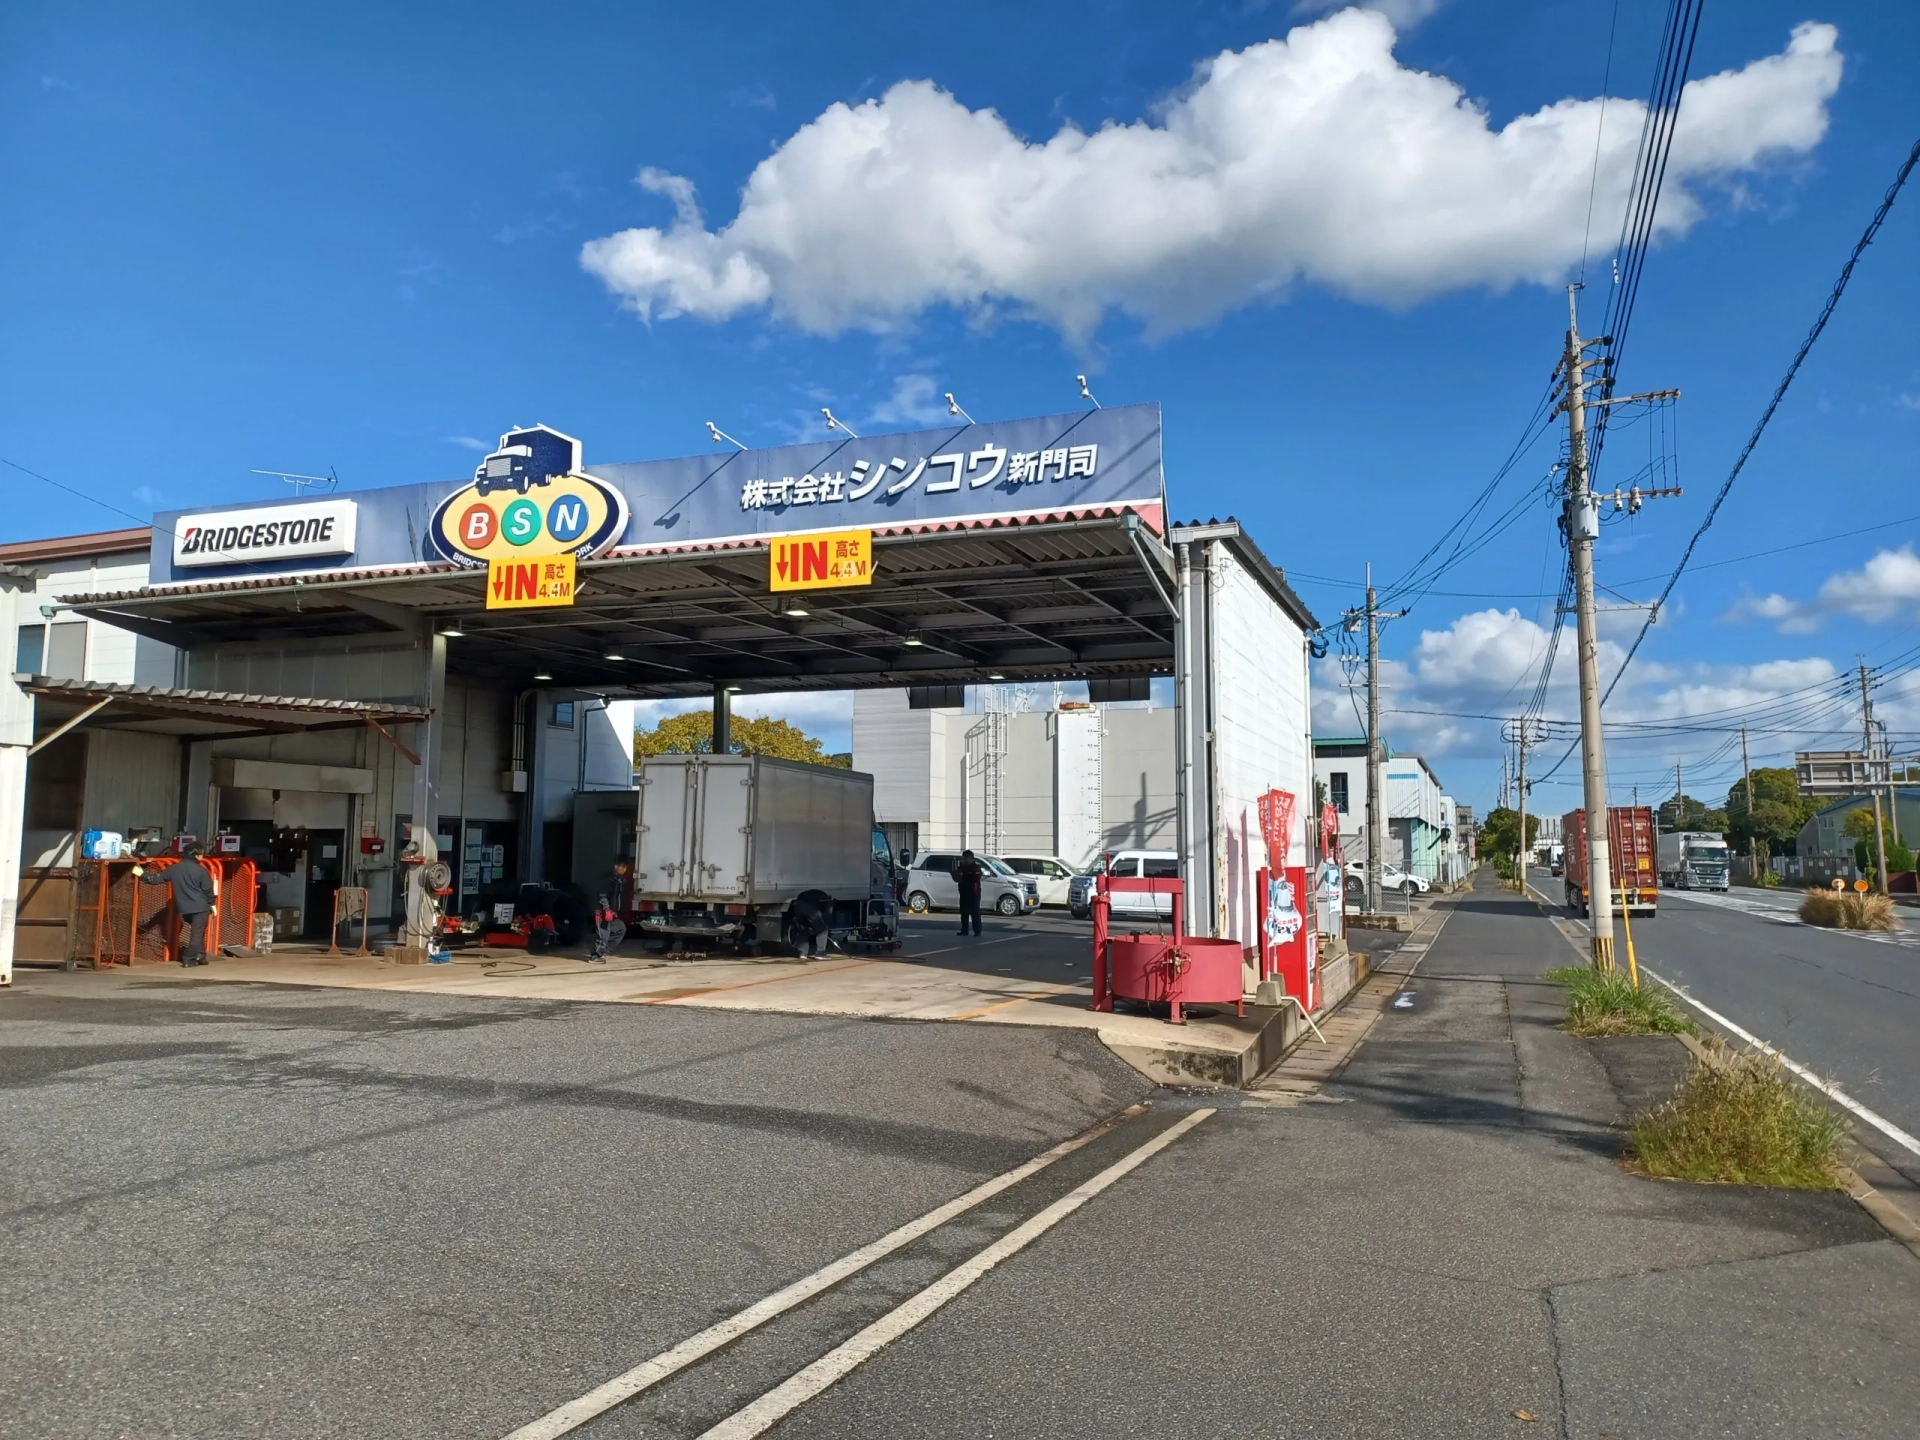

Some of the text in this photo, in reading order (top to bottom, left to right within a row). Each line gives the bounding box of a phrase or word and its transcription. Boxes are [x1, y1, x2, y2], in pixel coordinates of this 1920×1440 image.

[181, 517, 335, 554] BRIDGESTONE
[836, 540, 860, 558] 高さ
[544, 563, 566, 580] 高さ
[790, 541, 828, 582] IN
[503, 563, 539, 601] IN
[539, 582, 571, 598] 4.4M
